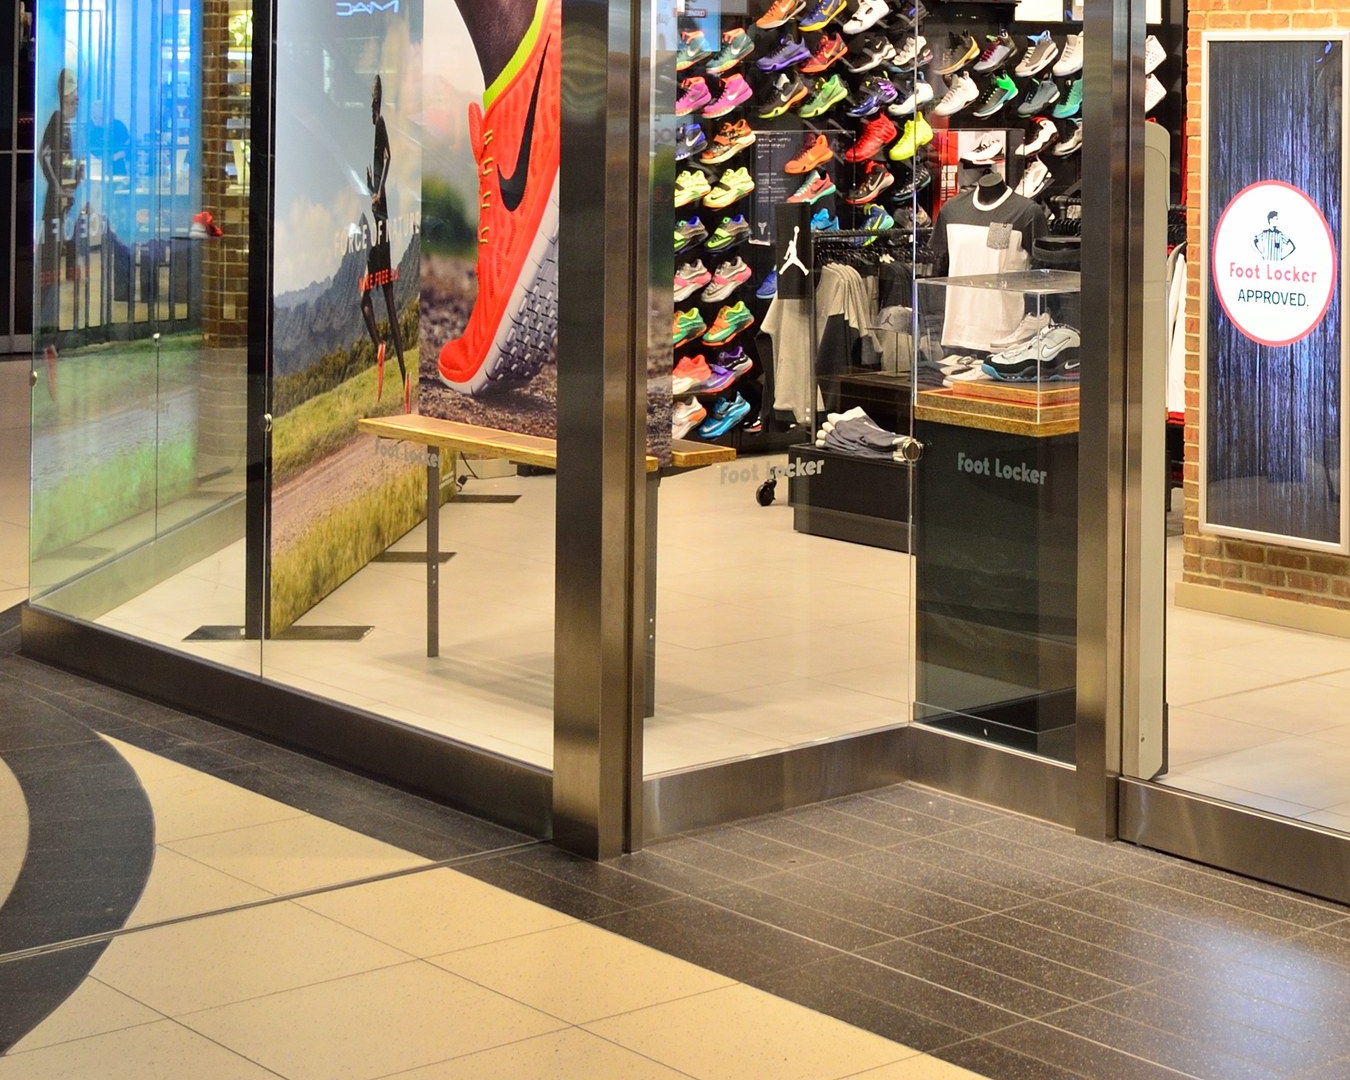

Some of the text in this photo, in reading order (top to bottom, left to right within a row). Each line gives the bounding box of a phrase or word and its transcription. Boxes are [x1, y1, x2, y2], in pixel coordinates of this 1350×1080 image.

[370, 219, 384, 247] OF
[1229, 261, 1317, 283] Foot Locker
[1237, 288, 1309, 308] APPROVED.
[719, 457, 825, 485] Foot Locker
[957, 451, 1047, 485] Foot Locker
